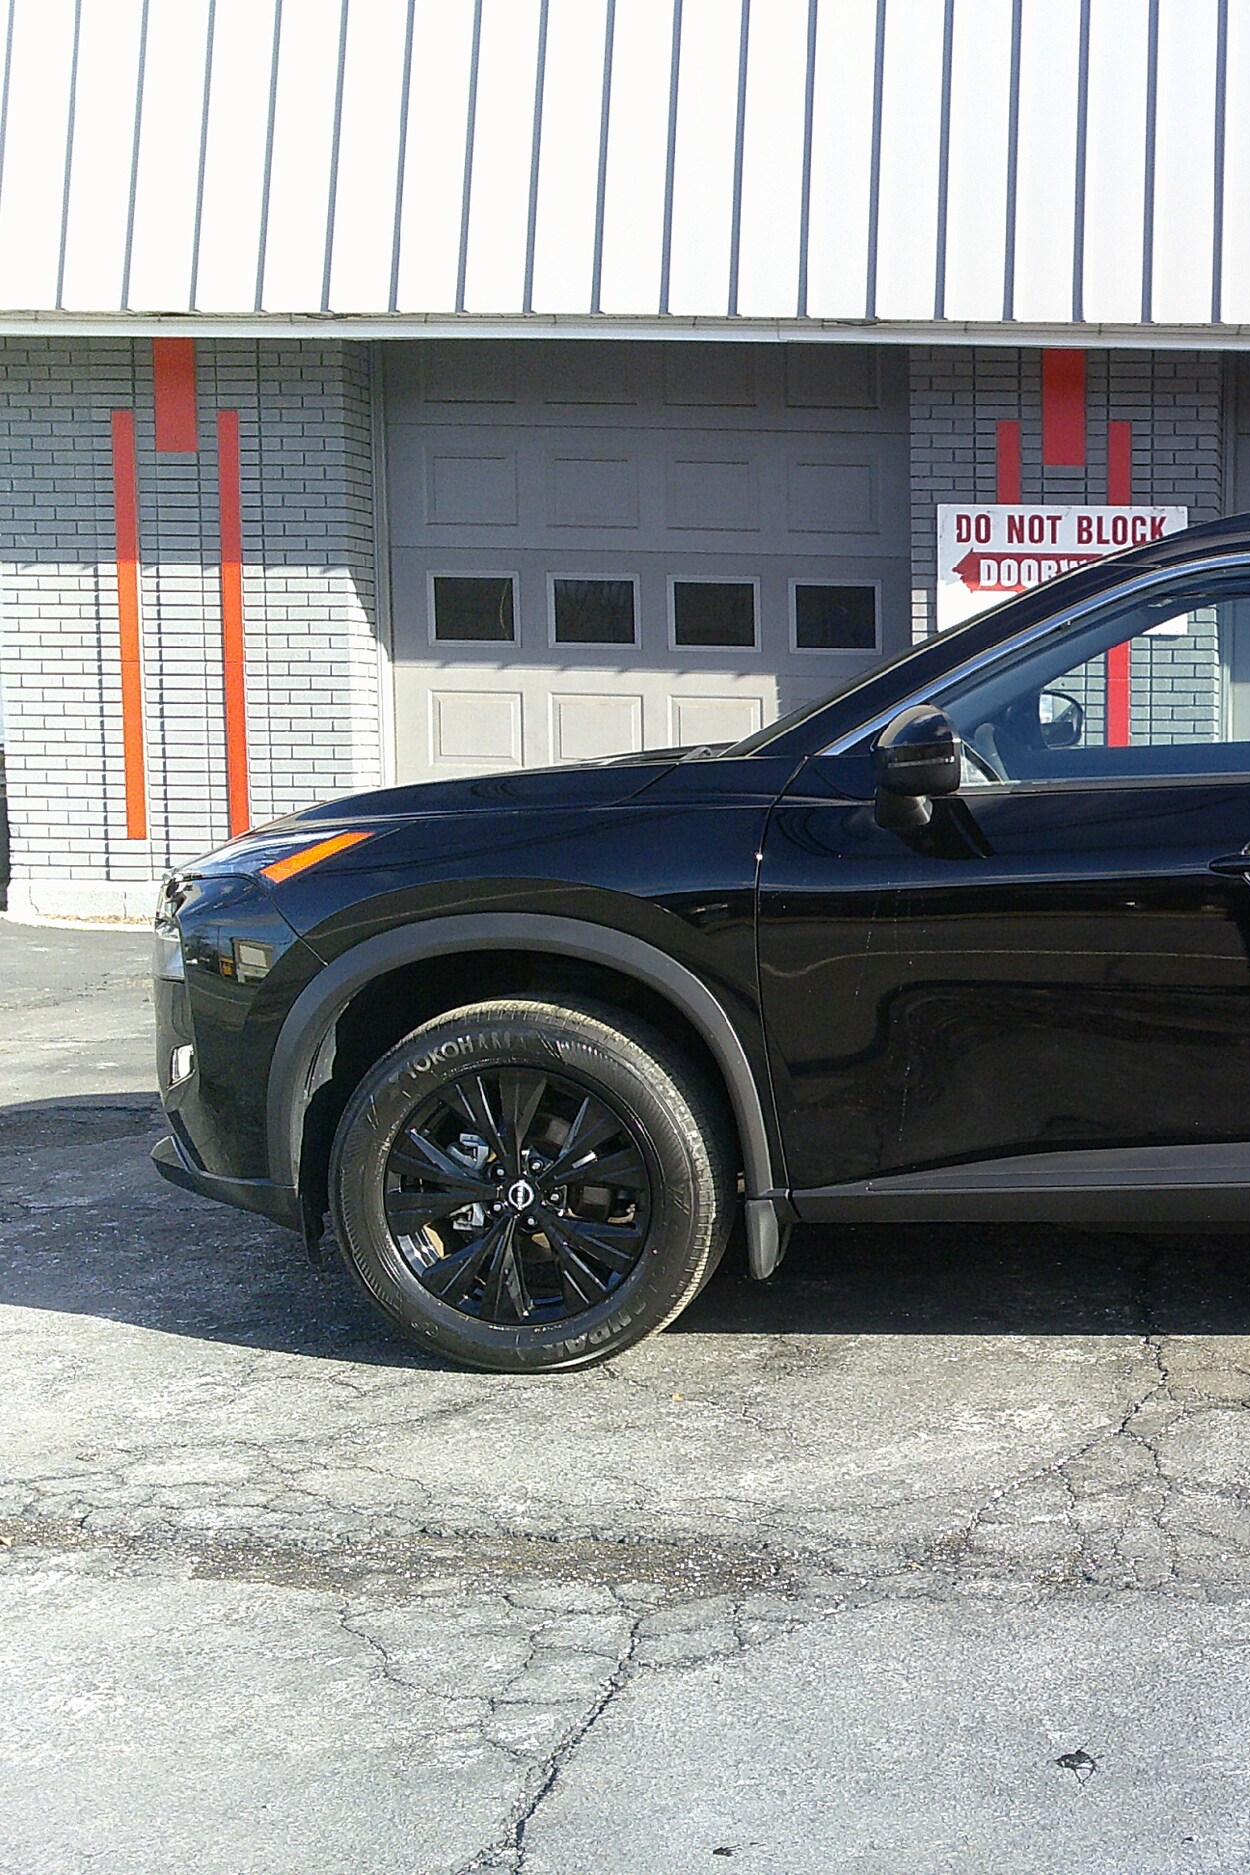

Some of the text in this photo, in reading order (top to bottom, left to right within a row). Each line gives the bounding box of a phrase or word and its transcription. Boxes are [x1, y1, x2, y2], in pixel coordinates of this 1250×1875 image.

[956, 514, 1167, 546] DO NOT BLOCK
